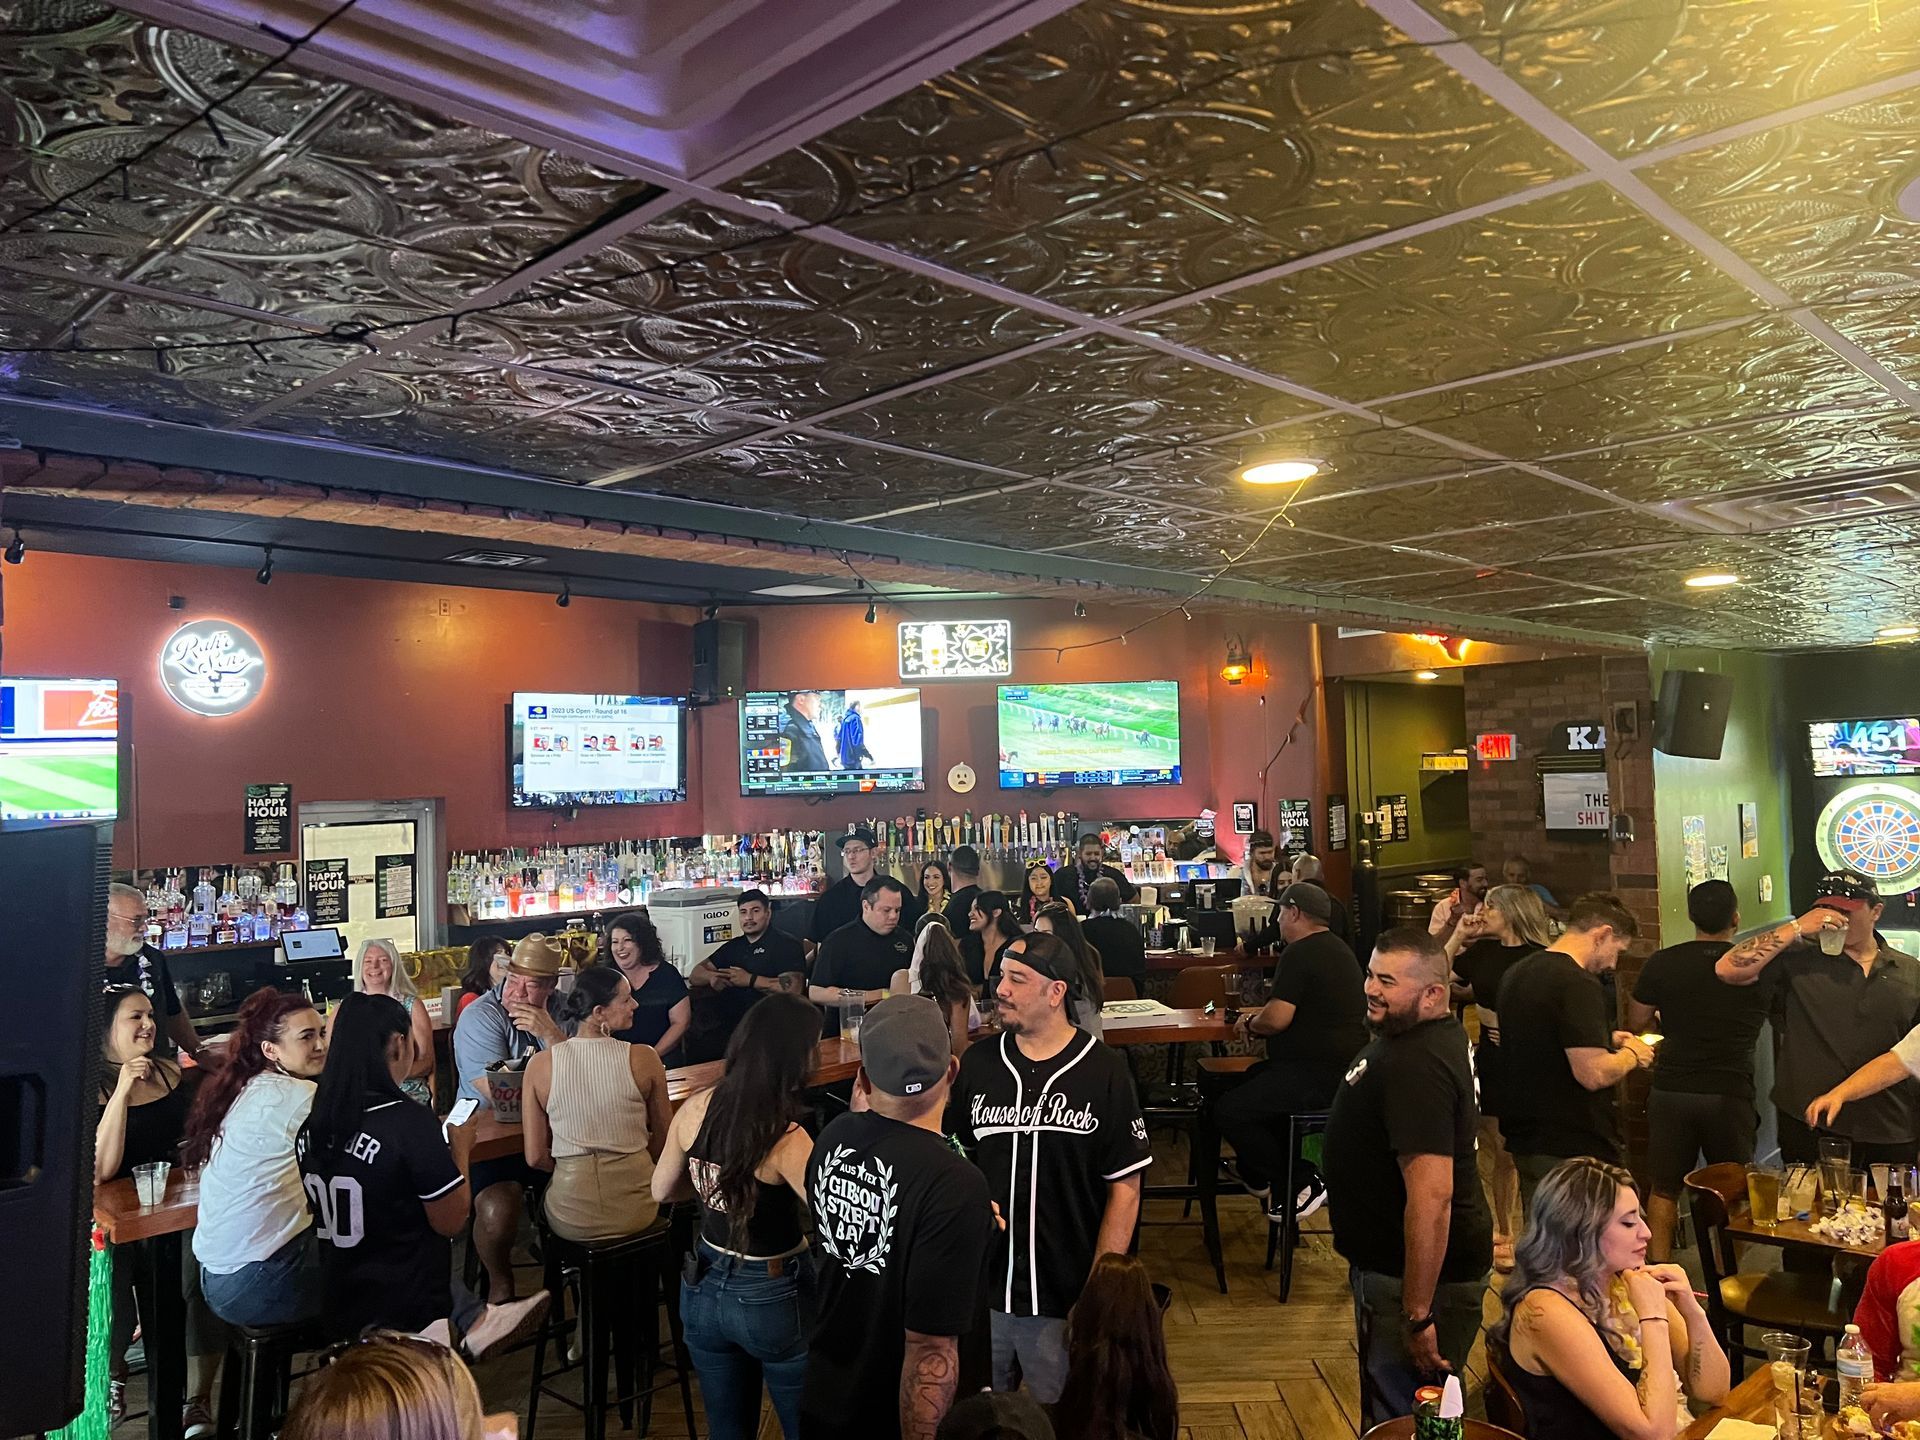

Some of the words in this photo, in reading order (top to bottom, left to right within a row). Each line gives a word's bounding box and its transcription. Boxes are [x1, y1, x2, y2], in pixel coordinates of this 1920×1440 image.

[1849, 725, 1907, 752] 451
[1482, 736, 1512, 759] EXIT
[247, 798, 286, 807] HAPPY
[1585, 793, 1609, 807] THE
[247, 807, 288, 817] HOUR
[1281, 811, 1307, 820] HAPPY
[1577, 811, 1606, 826] SHIT
[1281, 818, 1310, 828] HOUR
[308, 871, 344, 882] HAPPY
[308, 879, 346, 892] HOUR
[703, 910, 730, 920] IGLOO
[971, 1093, 1017, 1127] House
[1020, 1093, 1048, 1135] of
[1044, 1092, 1096, 1131] Rock
[839, 1162, 857, 1176] AUS
[863, 1171, 878, 1186] TEX
